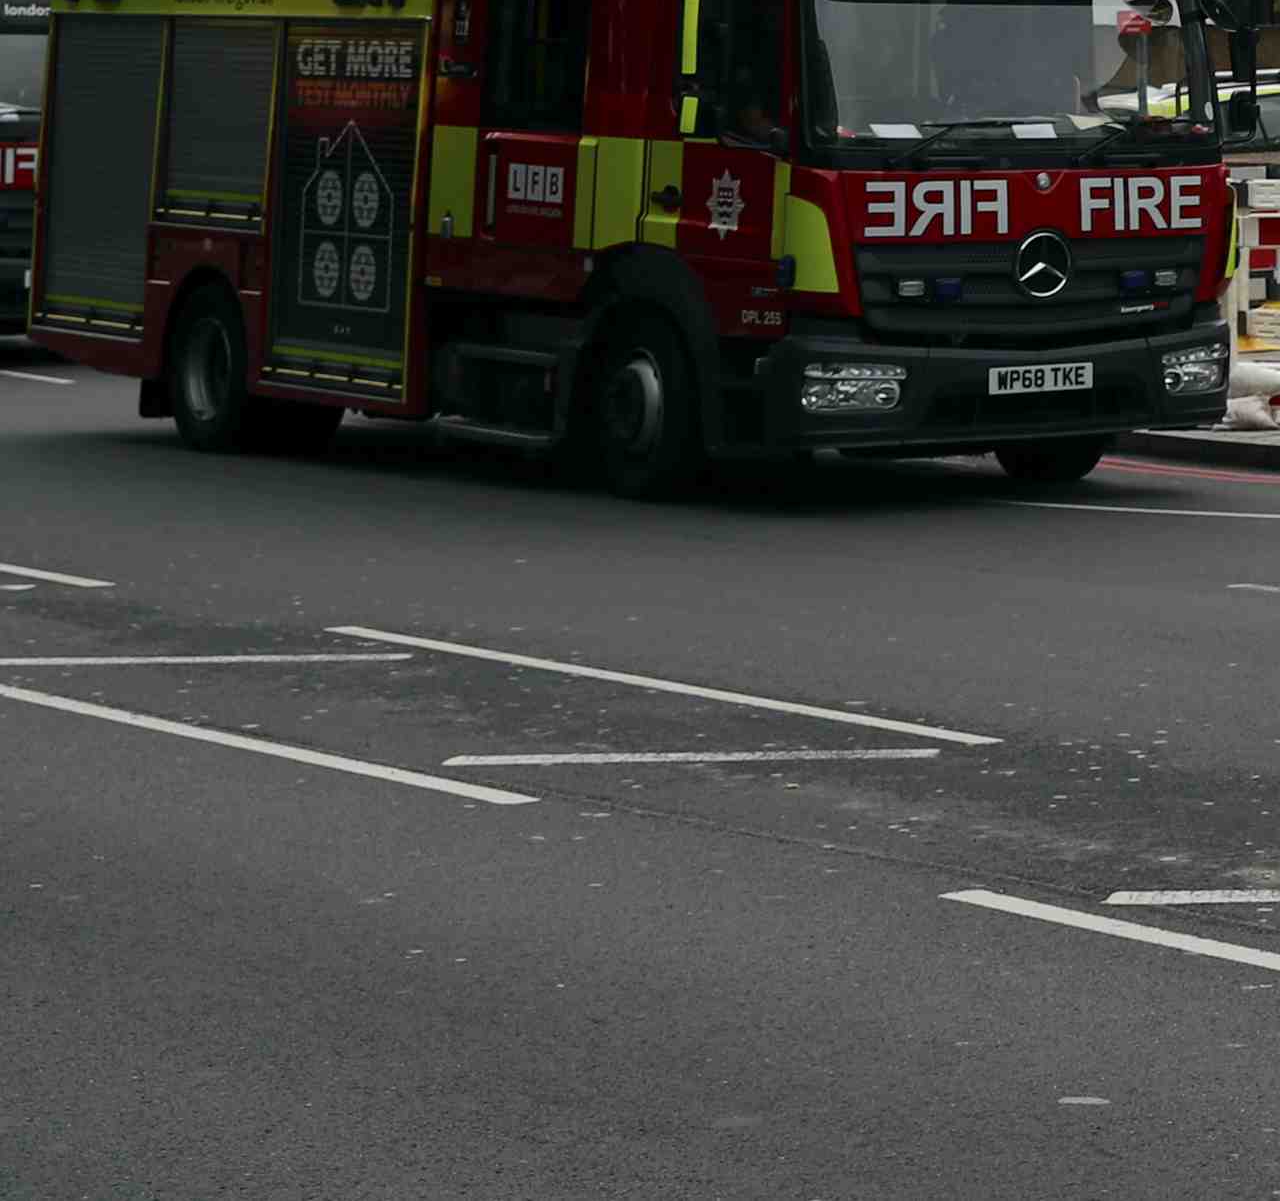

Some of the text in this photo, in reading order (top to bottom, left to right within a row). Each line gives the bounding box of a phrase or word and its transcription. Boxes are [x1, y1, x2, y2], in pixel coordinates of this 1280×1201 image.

[297, 39, 342, 76] GET
[345, 40, 414, 78] MORE
[1079, 175, 1202, 232] FIRE
[997, 365, 1086, 391] WP68 TKE
